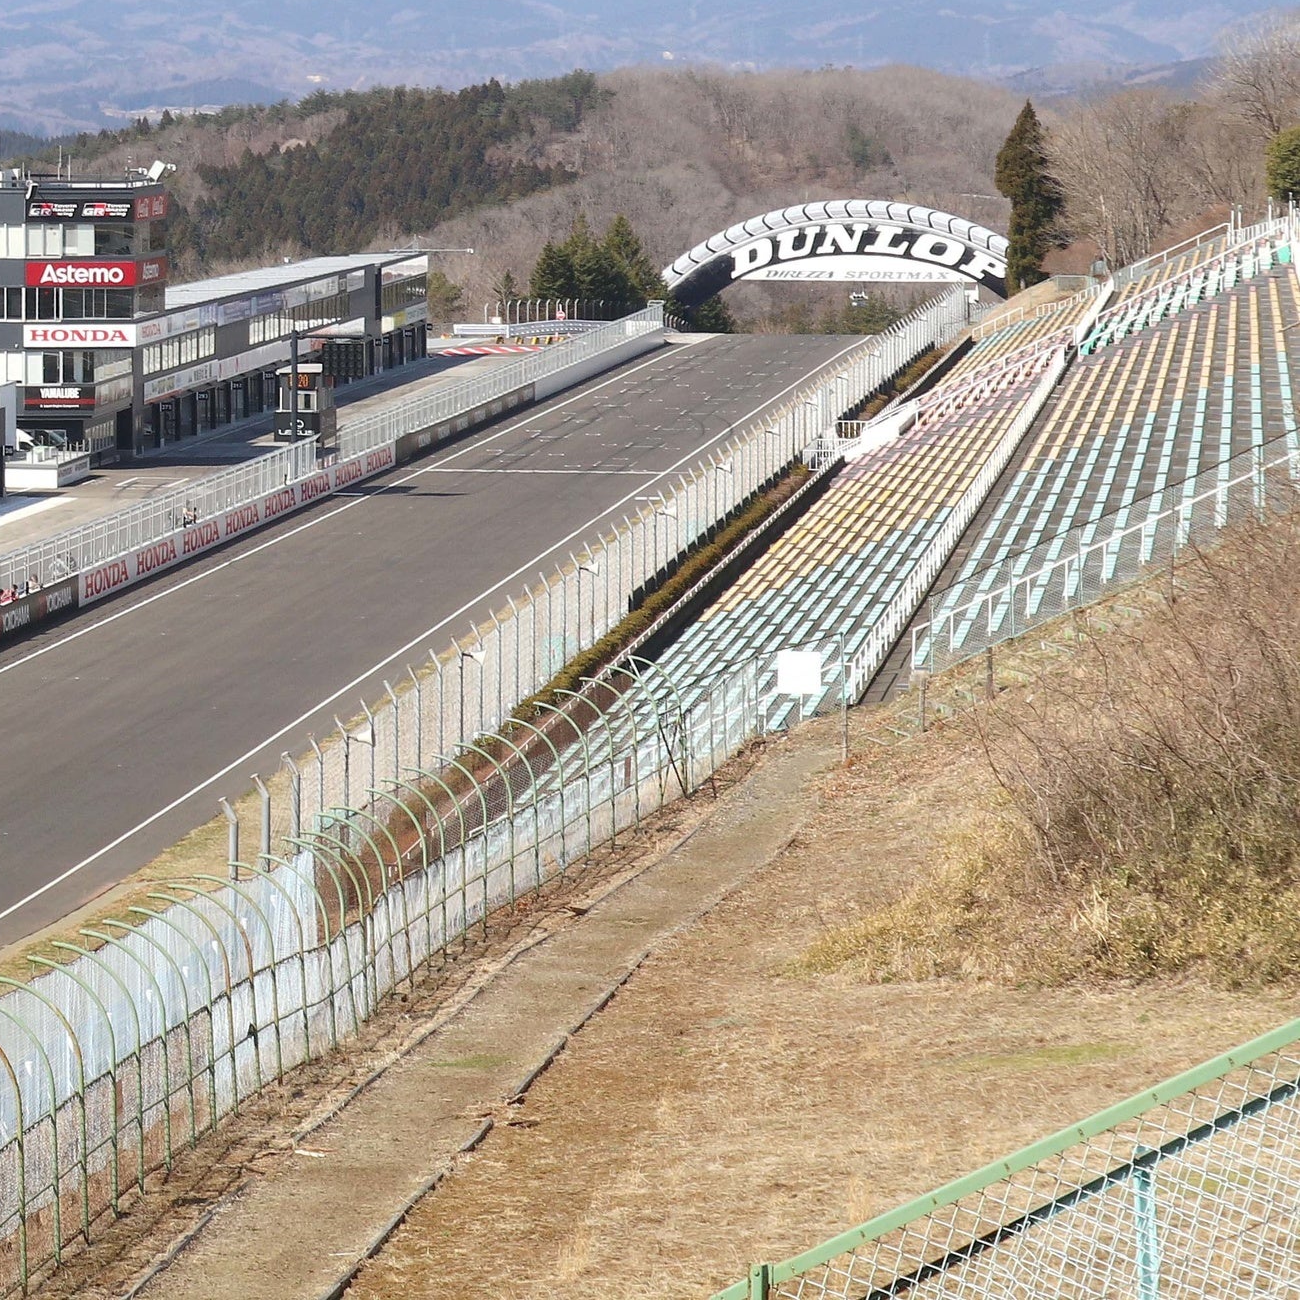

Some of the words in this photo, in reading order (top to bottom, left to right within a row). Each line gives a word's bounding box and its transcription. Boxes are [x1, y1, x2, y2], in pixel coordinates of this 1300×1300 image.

[731, 223, 1007, 280] DUNLOP
[40, 264, 123, 283] Astemo
[766, 269, 835, 279] DIREZZA
[844, 270, 950, 280] SPORTMAX
[30, 330, 128, 341] HONDA
[40, 388, 80, 398] YAMALUBE
[335, 458, 363, 485] HONDA
[367, 447, 393, 473] HONDA
[301, 472, 330, 500] HONDA
[265, 487, 296, 518] HONDA
[226, 504, 259, 535] HONDA
[183, 521, 220, 555] HONDA
[136, 539, 176, 575] HONDA
[85, 560, 128, 599] HONDA
[46, 586, 72, 613] YOKOHAMA
[2, 604, 30, 632] YOKOHAMA
